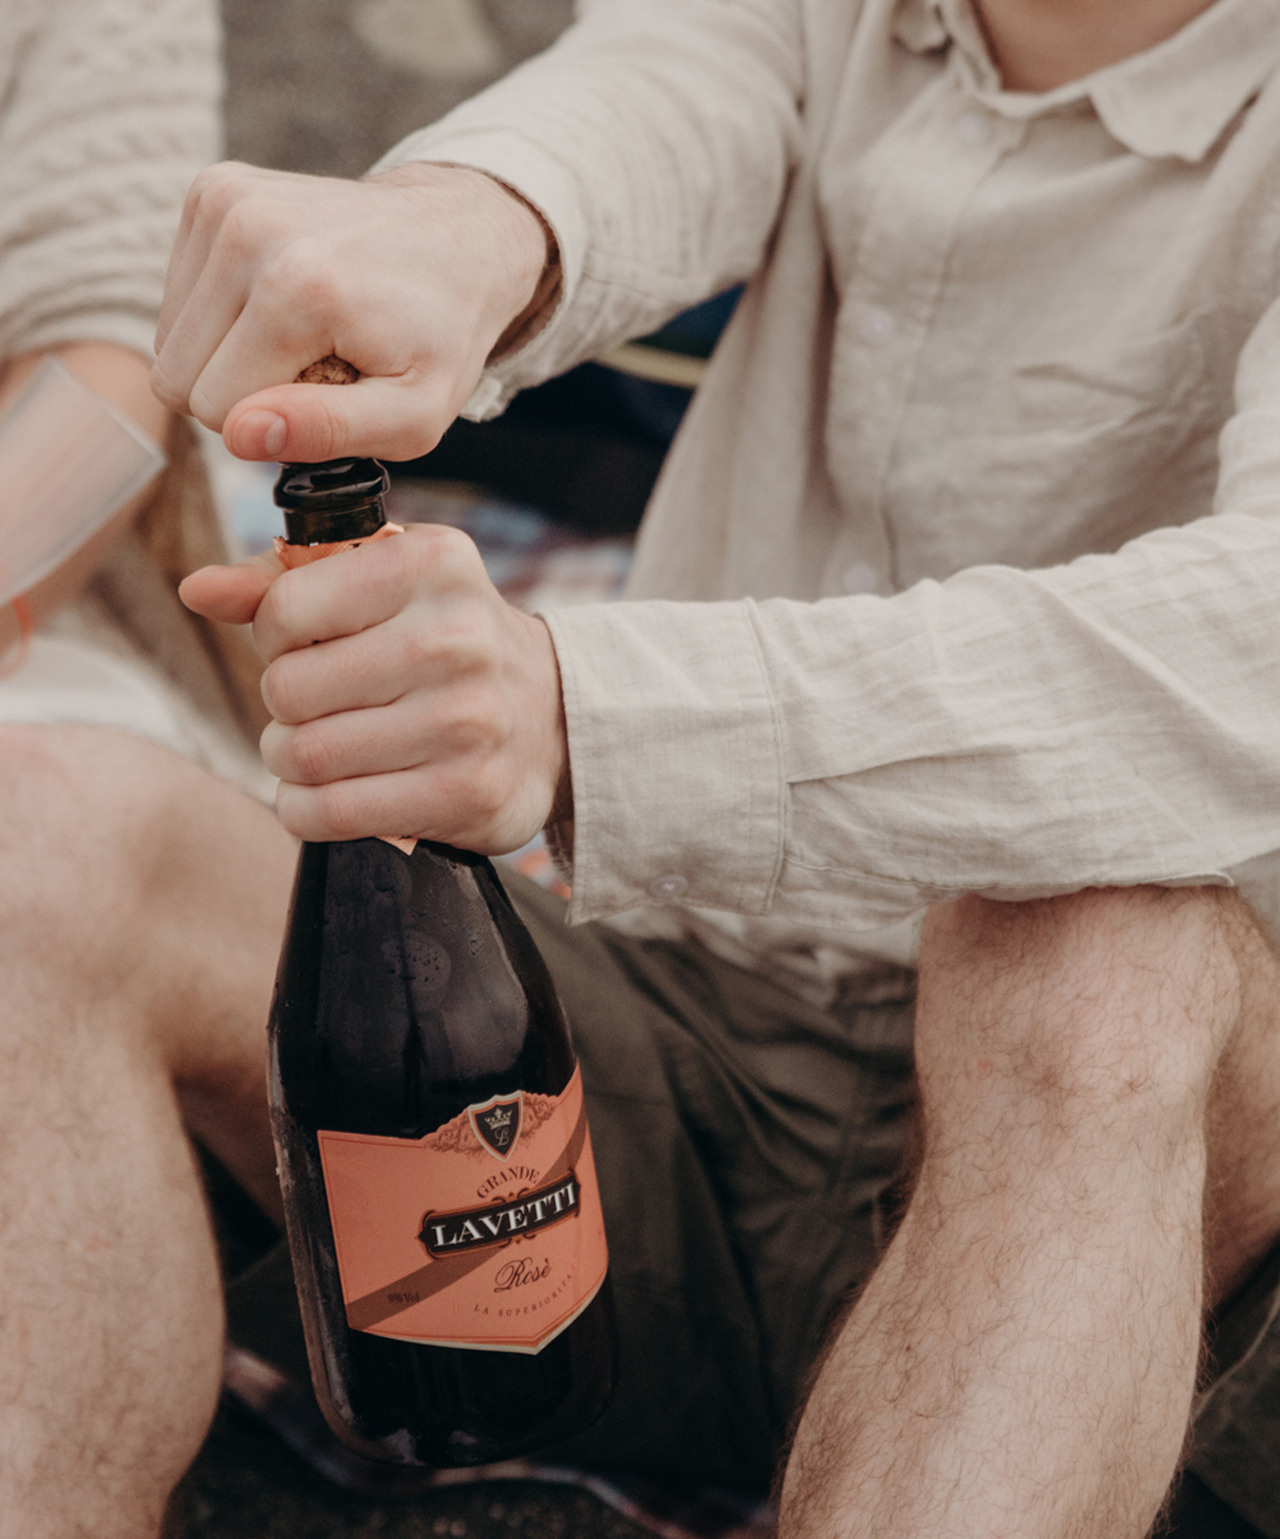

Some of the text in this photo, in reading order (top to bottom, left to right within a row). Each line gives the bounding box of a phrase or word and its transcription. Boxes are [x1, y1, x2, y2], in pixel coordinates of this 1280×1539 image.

[476, 1166, 540, 1199] GRANDE
[431, 1182, 576, 1247] LAVETTI
[474, 1304, 489, 1315] LA
